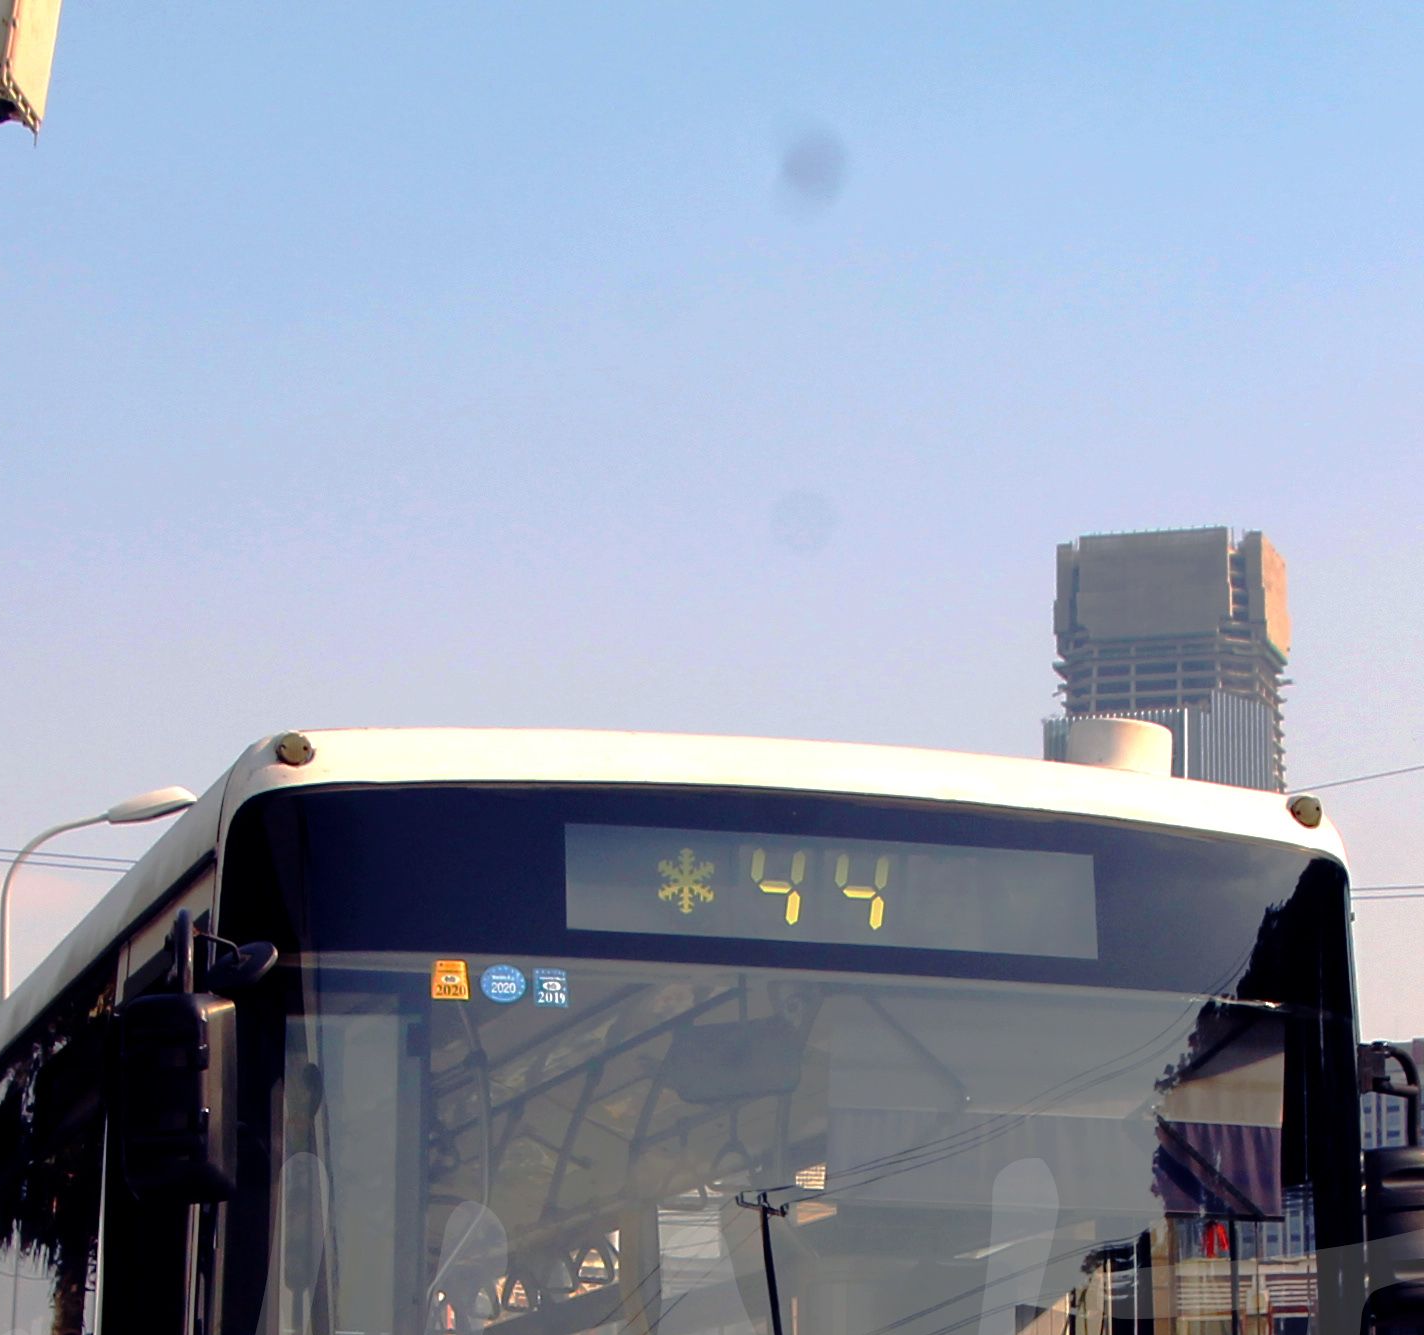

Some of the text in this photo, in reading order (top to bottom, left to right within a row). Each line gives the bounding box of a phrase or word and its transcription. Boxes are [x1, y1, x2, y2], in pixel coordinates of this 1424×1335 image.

[750, 847, 889, 931] 44
[435, 983, 467, 997] 2020
[491, 982, 516, 994] 2020
[538, 991, 566, 1004] 2019
